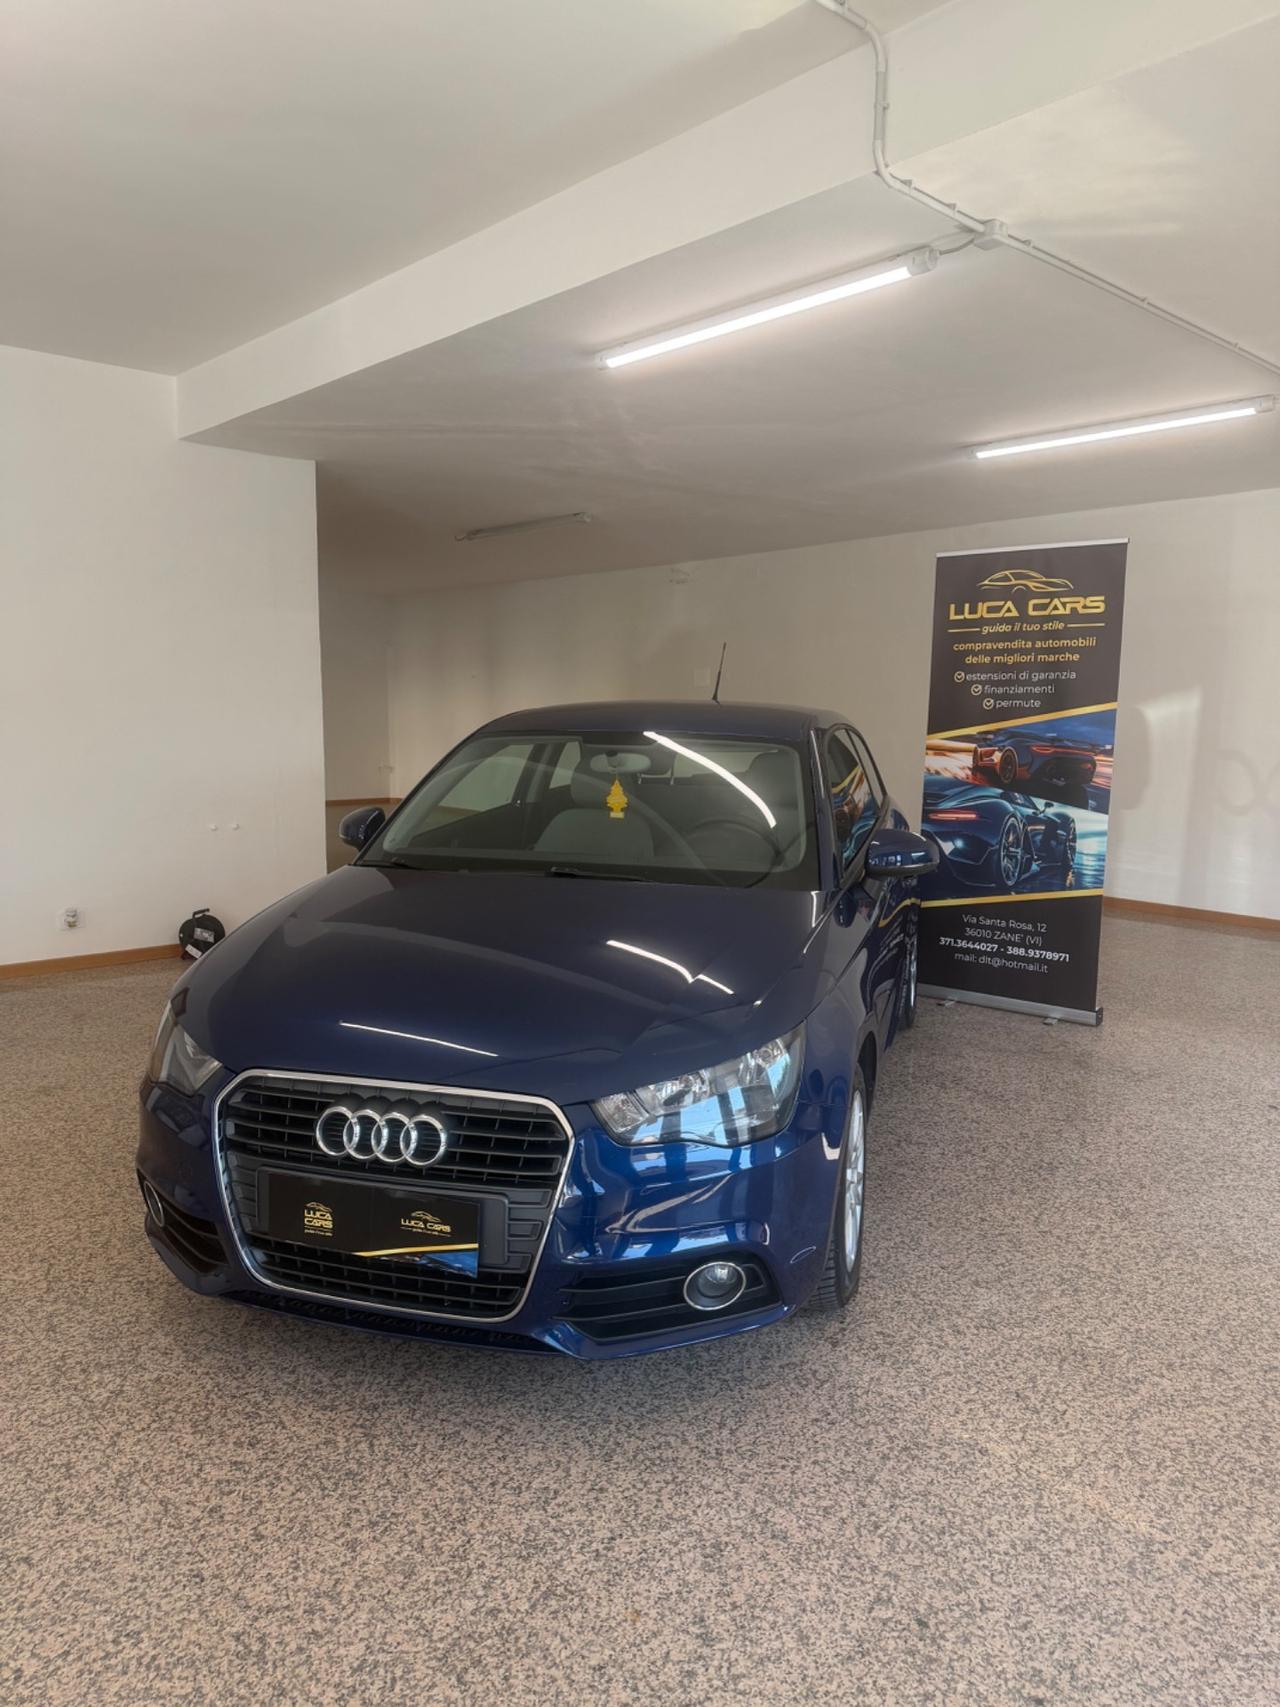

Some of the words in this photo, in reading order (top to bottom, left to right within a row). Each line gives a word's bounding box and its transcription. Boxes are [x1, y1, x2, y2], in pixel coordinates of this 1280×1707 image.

[950, 600, 1019, 620] LUCA
[1028, 596, 1105, 616] CARS
[982, 624, 1011, 635] guida
[1013, 622, 1021, 632] il
[1022, 623, 1040, 632] tuo
[1042, 620, 1065, 631] stile
[953, 640, 1032, 652] compravendita
[1035, 637, 1096, 649] automobili
[965, 654, 991, 664] delle
[993, 652, 1035, 666] migliori
[1037, 652, 1080, 663] marche
[966, 671, 1017, 682] estensioni
[1019, 670, 1029, 680] di
[1031, 669, 1077, 682] garanzia
[984, 684, 1055, 694] finanziamenti
[996, 699, 1041, 710] permute
[962, 914, 977, 924] Via
[979, 915, 1006, 928] Santa
[1009, 919, 1034, 932] Rosa,
[1037, 922, 1048, 933] 12
[964, 927, 992, 939] 36010
[939, 936, 998, 952] 371.3644027
[1006, 946, 1070, 963] 388.9378971
[954, 952, 977, 963] mail:
[304, 1209, 333, 1220] LUCA
[304, 1218, 333, 1229] CARS
[401, 1218, 425, 1228] LUCA
